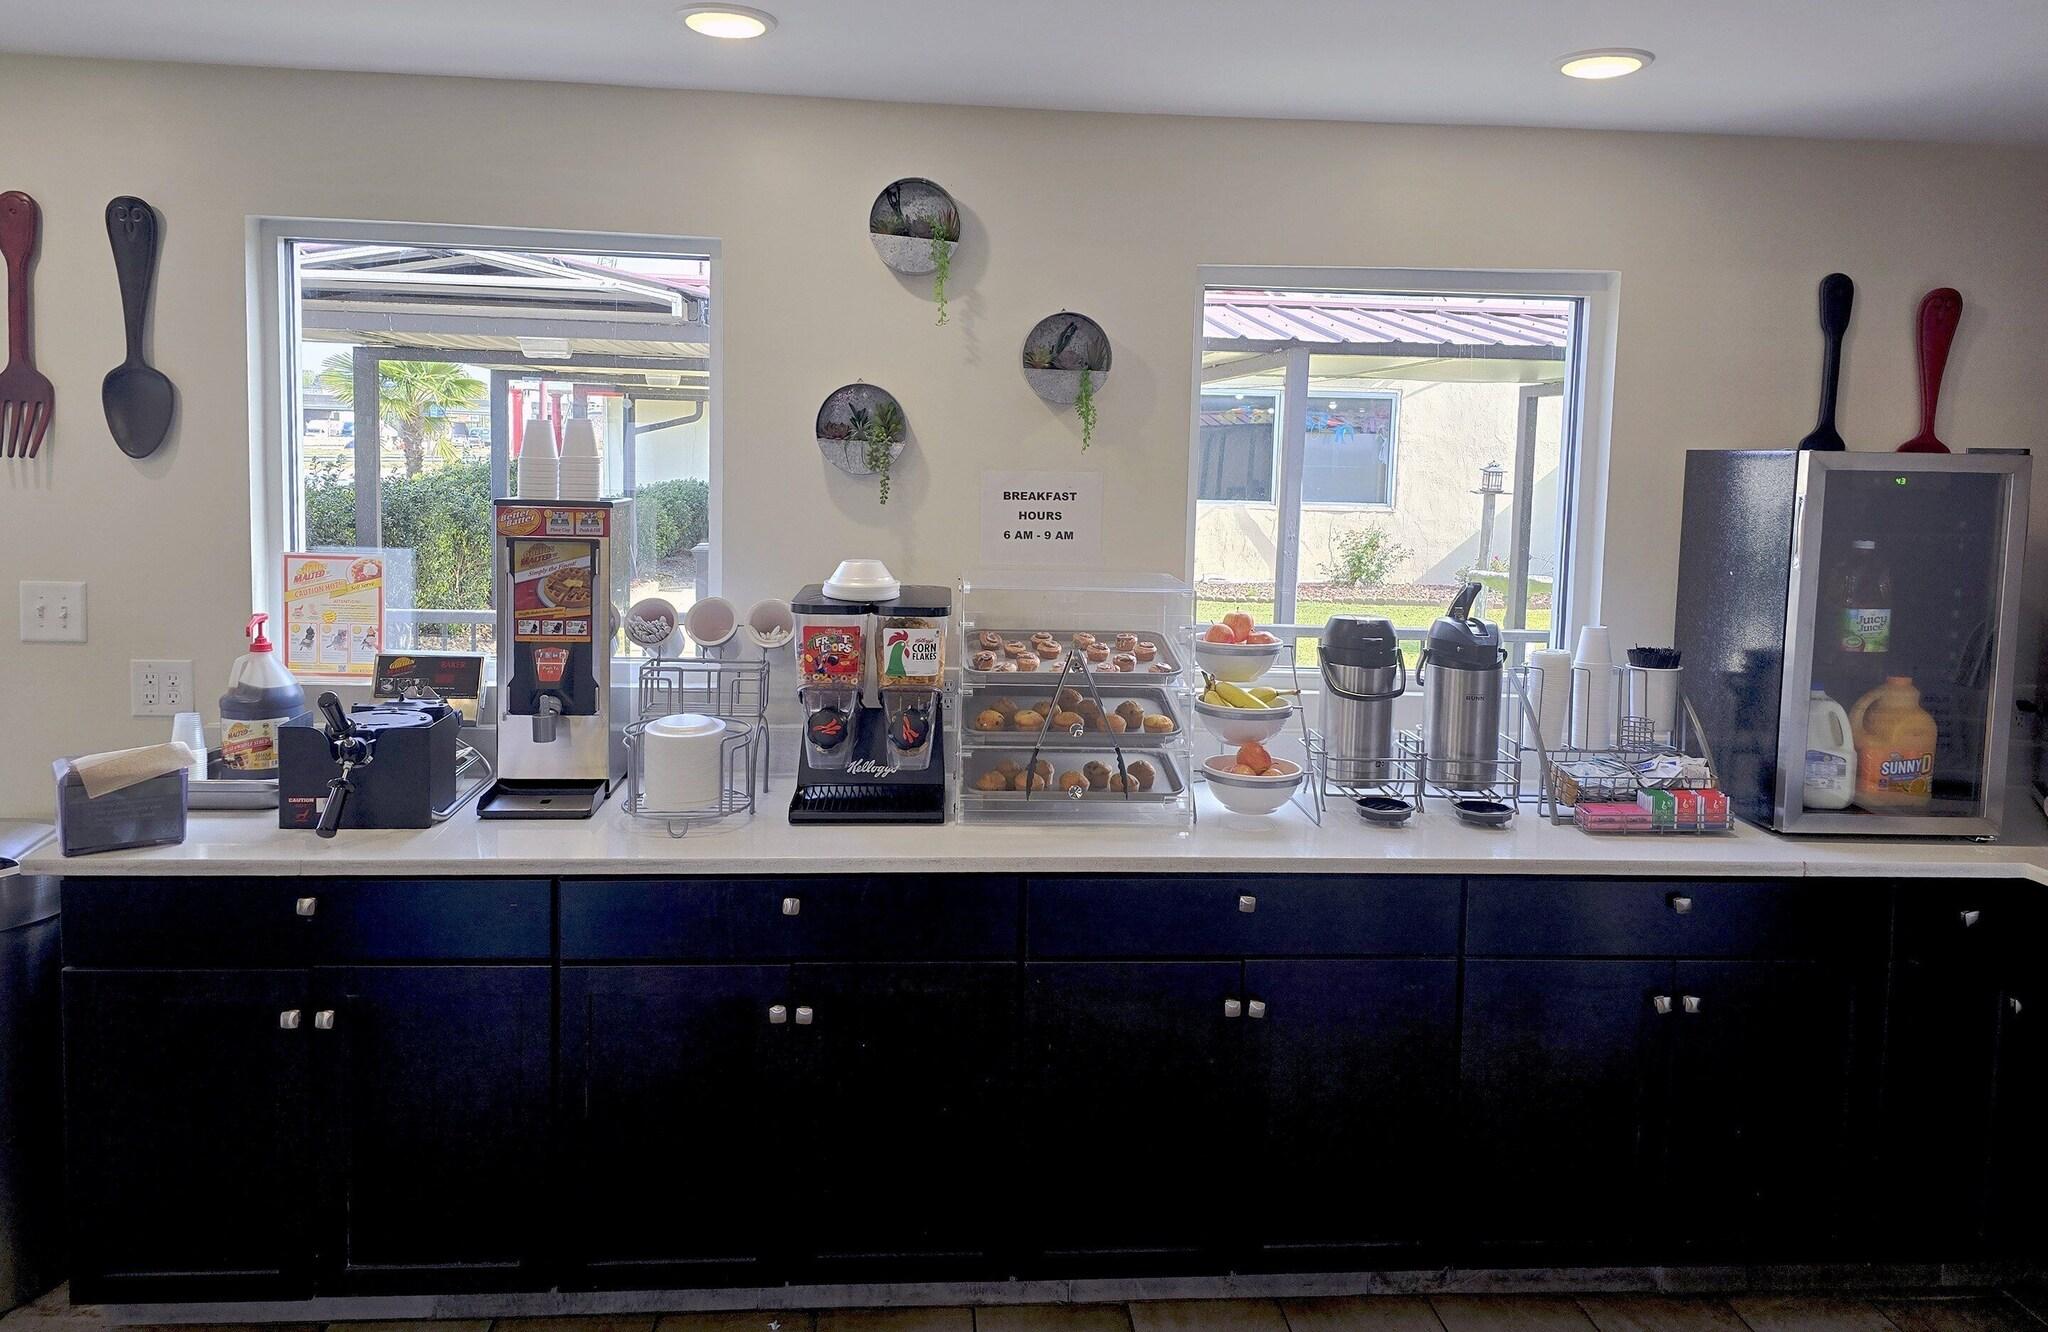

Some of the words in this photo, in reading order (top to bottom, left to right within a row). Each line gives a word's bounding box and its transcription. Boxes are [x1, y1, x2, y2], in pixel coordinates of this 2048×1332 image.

[1003, 491, 1077, 501] BREAKFAST
[1018, 511, 1062, 521] HOURS
[1003, 530, 1011, 540] 6
[1014, 530, 1033, 540] AM
[1044, 530, 1052, 540] 9
[1055, 531, 1074, 540] AM
[528, 566, 548, 577] Simply
[294, 584, 324, 598] CAUTION
[1857, 615, 1887, 626] Juicy
[820, 642, 853, 653] LOOPS
[912, 643, 937, 653] CORN
[912, 652, 937, 660] FLAKES
